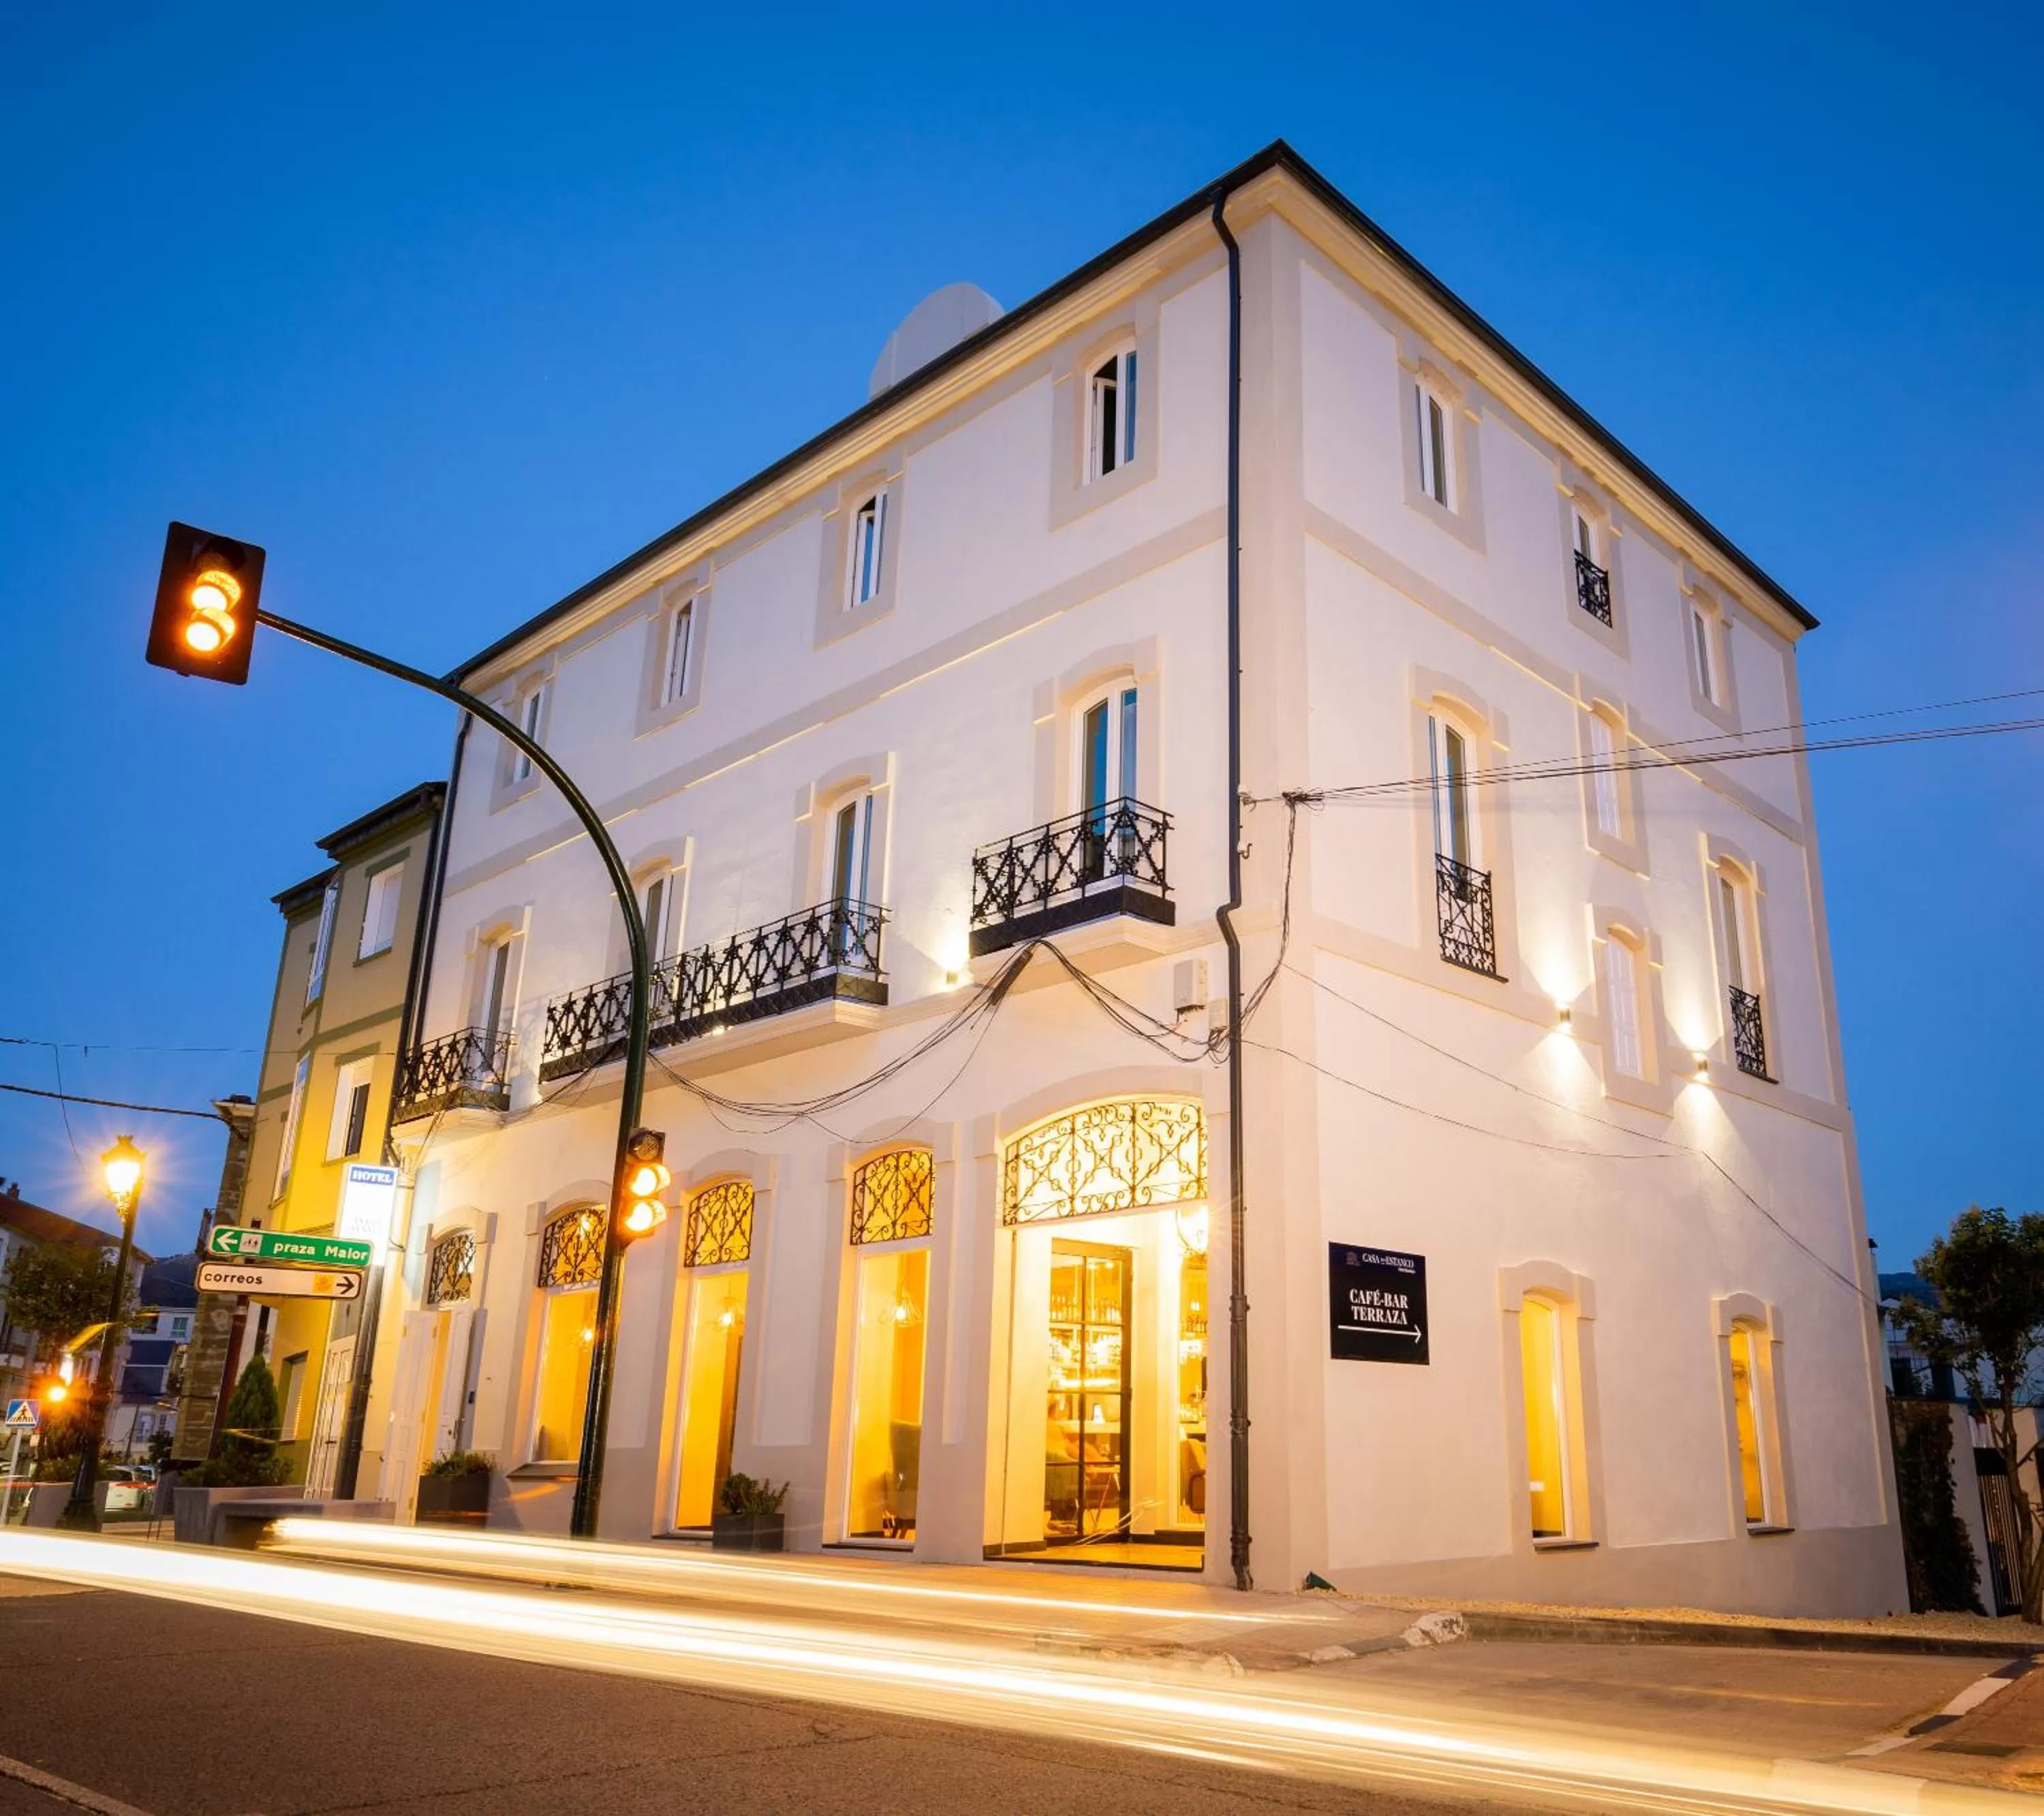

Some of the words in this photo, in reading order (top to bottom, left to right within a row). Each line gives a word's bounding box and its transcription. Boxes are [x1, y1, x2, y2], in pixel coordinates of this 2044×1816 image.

[352, 1170, 392, 1183] HOTEL
[273, 1242, 315, 1255] praza
[324, 1245, 368, 1261] Maior
[1362, 1253, 1380, 1264] CASA
[204, 1271, 263, 1285] correos
[1350, 1288, 1408, 1309] CAFÉ-BAR
[1351, 1306, 1408, 1325] TERRAZA
